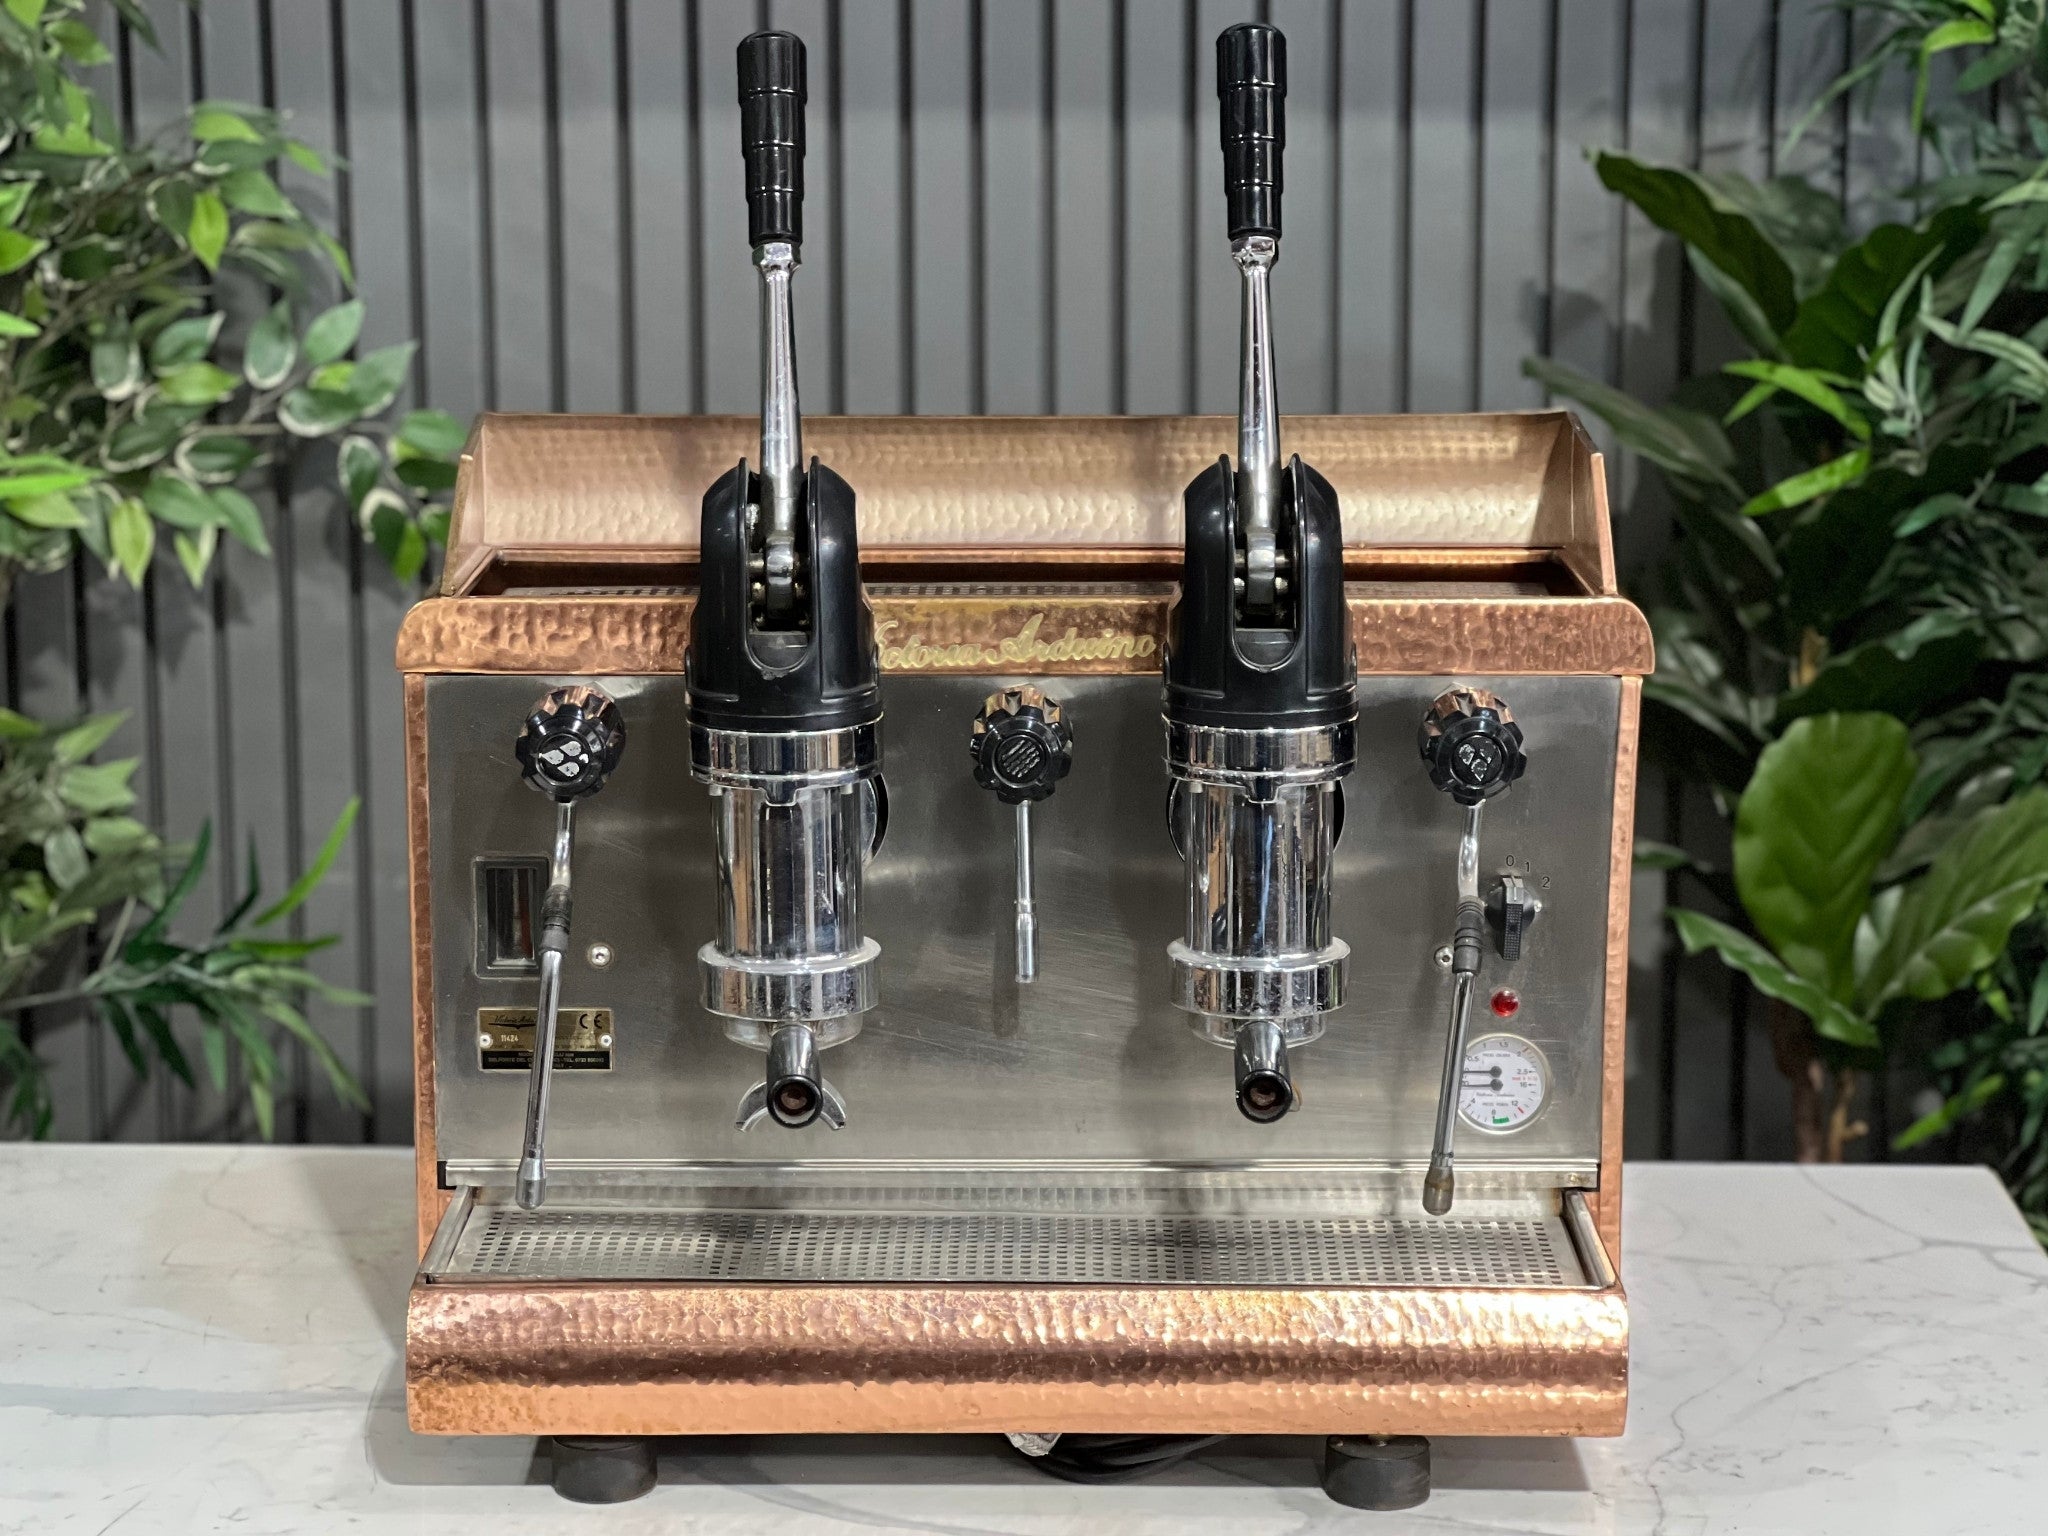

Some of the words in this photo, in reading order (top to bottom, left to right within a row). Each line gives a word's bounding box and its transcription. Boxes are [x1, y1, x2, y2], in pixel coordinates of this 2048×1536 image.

[1506, 855, 1514, 866] 0
[1525, 861, 1530, 873] 1
[1542, 876, 1550, 889] 2
